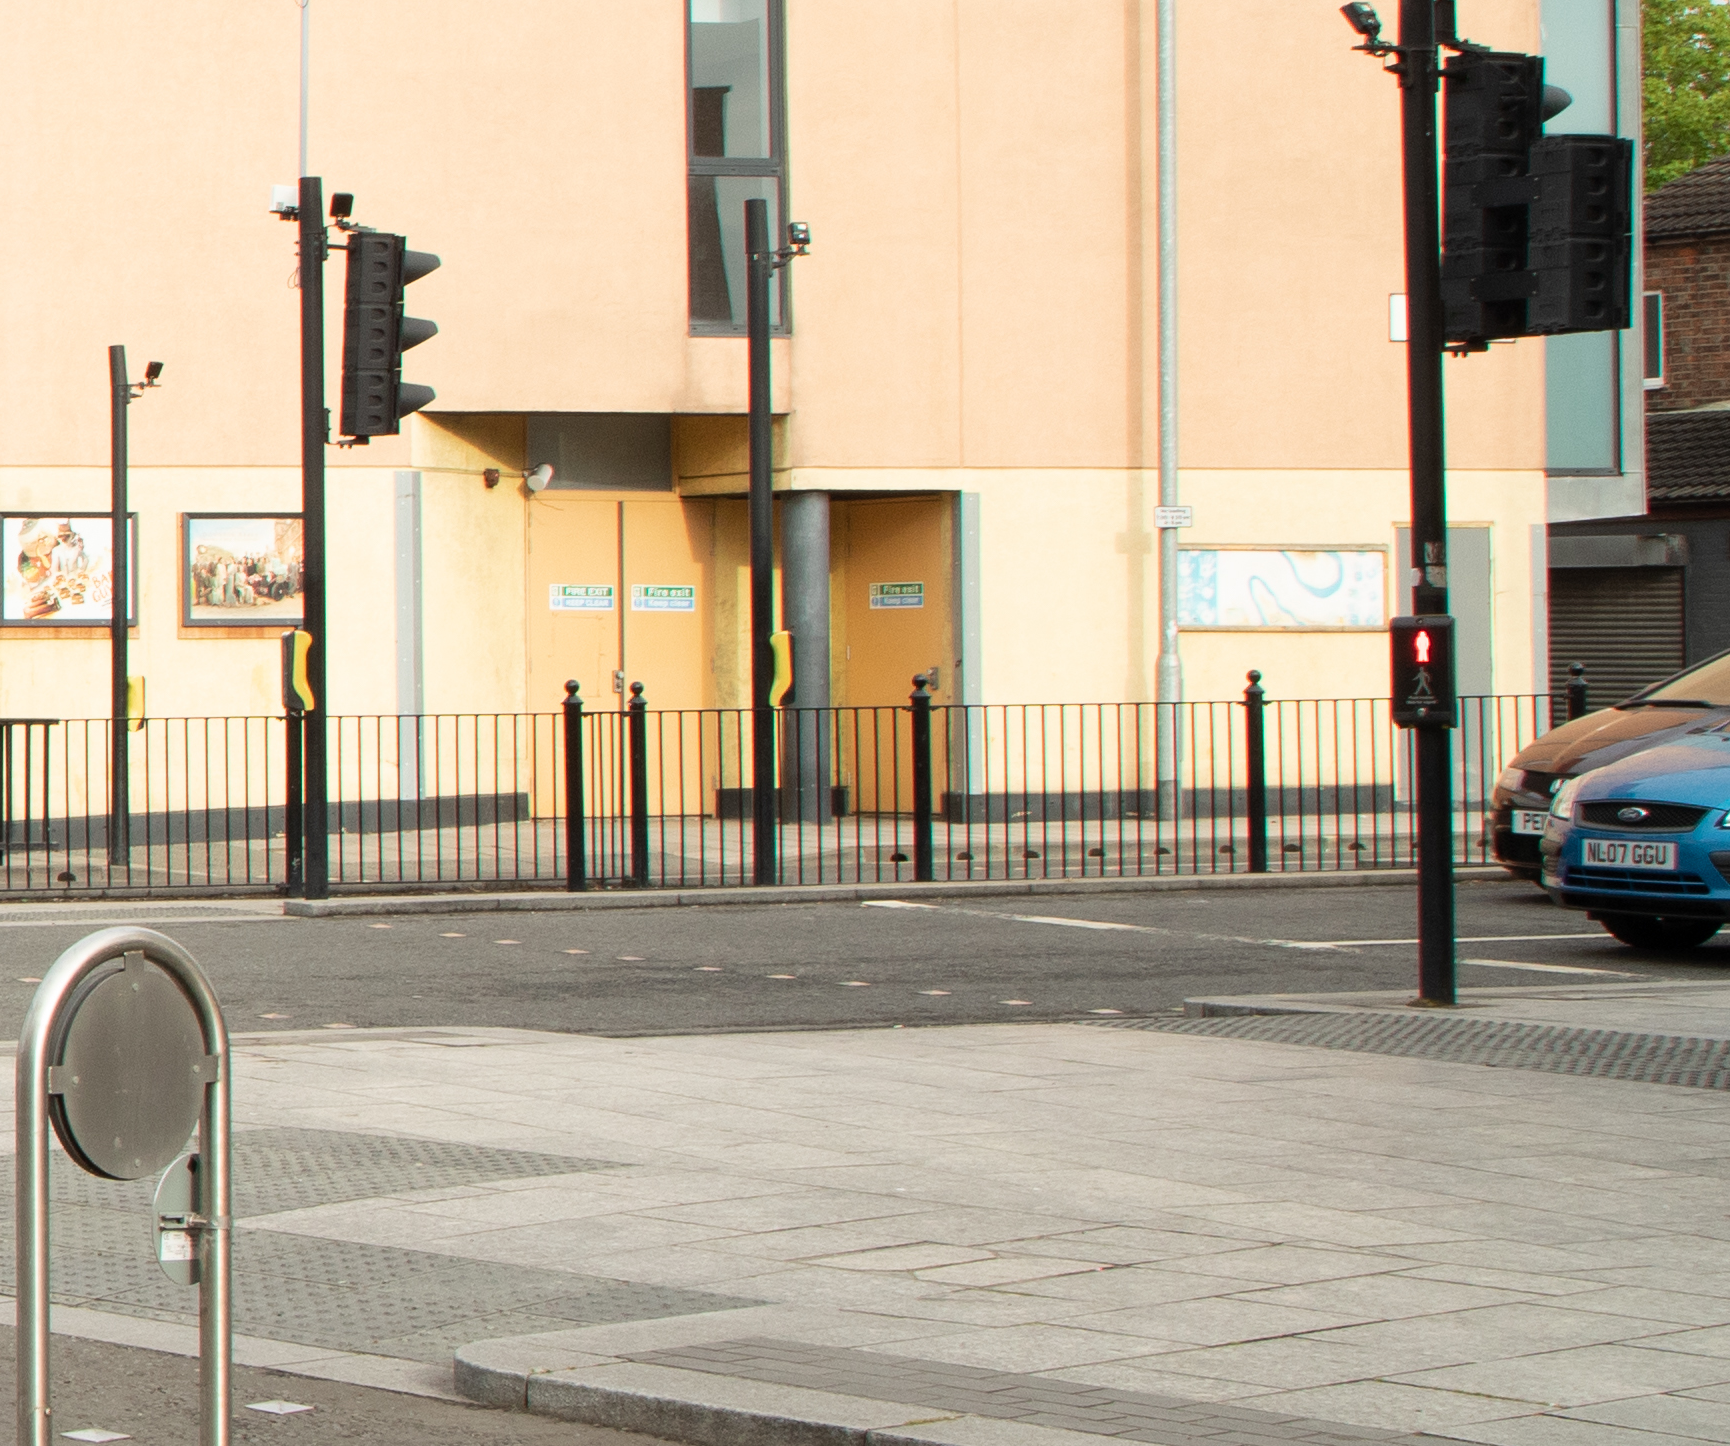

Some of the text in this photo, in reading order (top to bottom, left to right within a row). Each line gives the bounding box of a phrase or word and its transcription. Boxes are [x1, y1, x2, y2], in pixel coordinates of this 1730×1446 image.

[565, 587, 609, 596] FIRE EXIT
[647, 587, 691, 597] Fire exit
[565, 599, 609, 607] KEEP CLEAR
[1587, 842, 1668, 865] NL07 GGU
